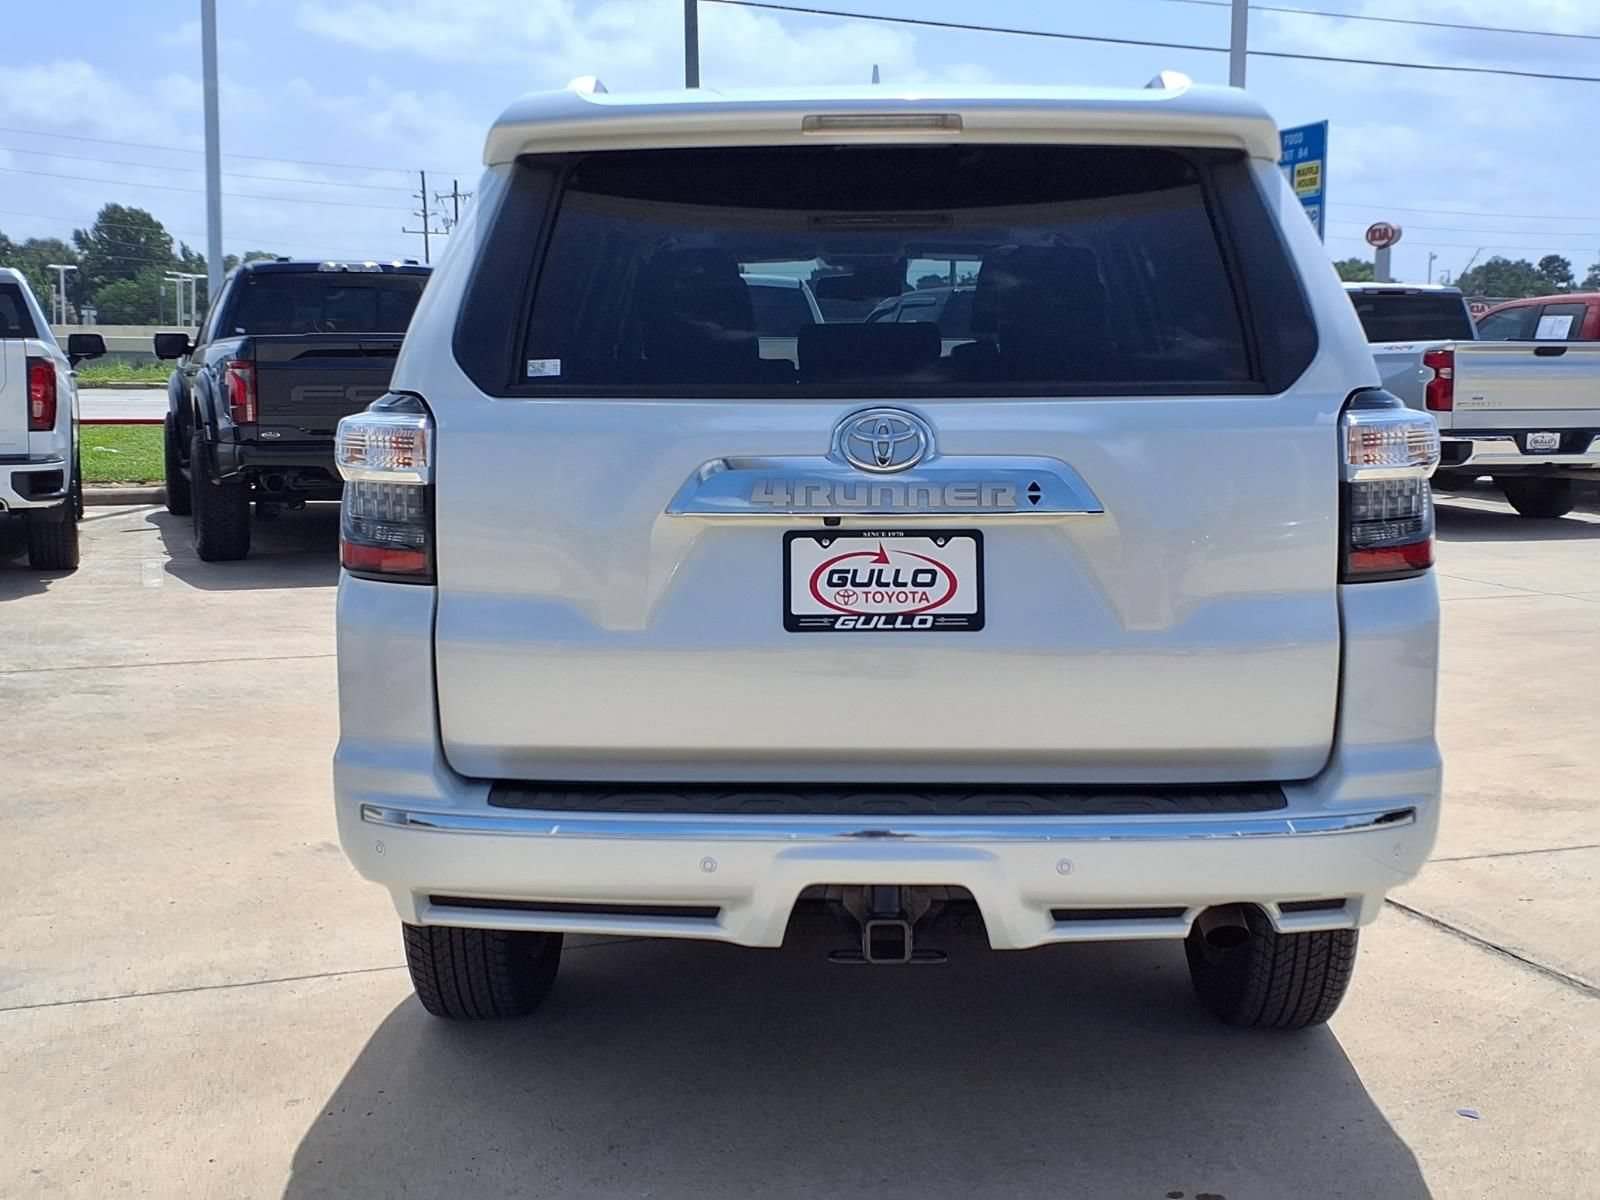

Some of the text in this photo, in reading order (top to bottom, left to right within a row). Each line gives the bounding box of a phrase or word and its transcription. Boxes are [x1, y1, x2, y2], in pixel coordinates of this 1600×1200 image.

[1284, 132, 1304, 146] FOOD
[1370, 228, 1391, 240] KIA
[291, 386, 390, 401] FO
[826, 568, 938, 588] GULLO
[862, 591, 930, 604] TOYOTA
[834, 615, 935, 629] GULLO
